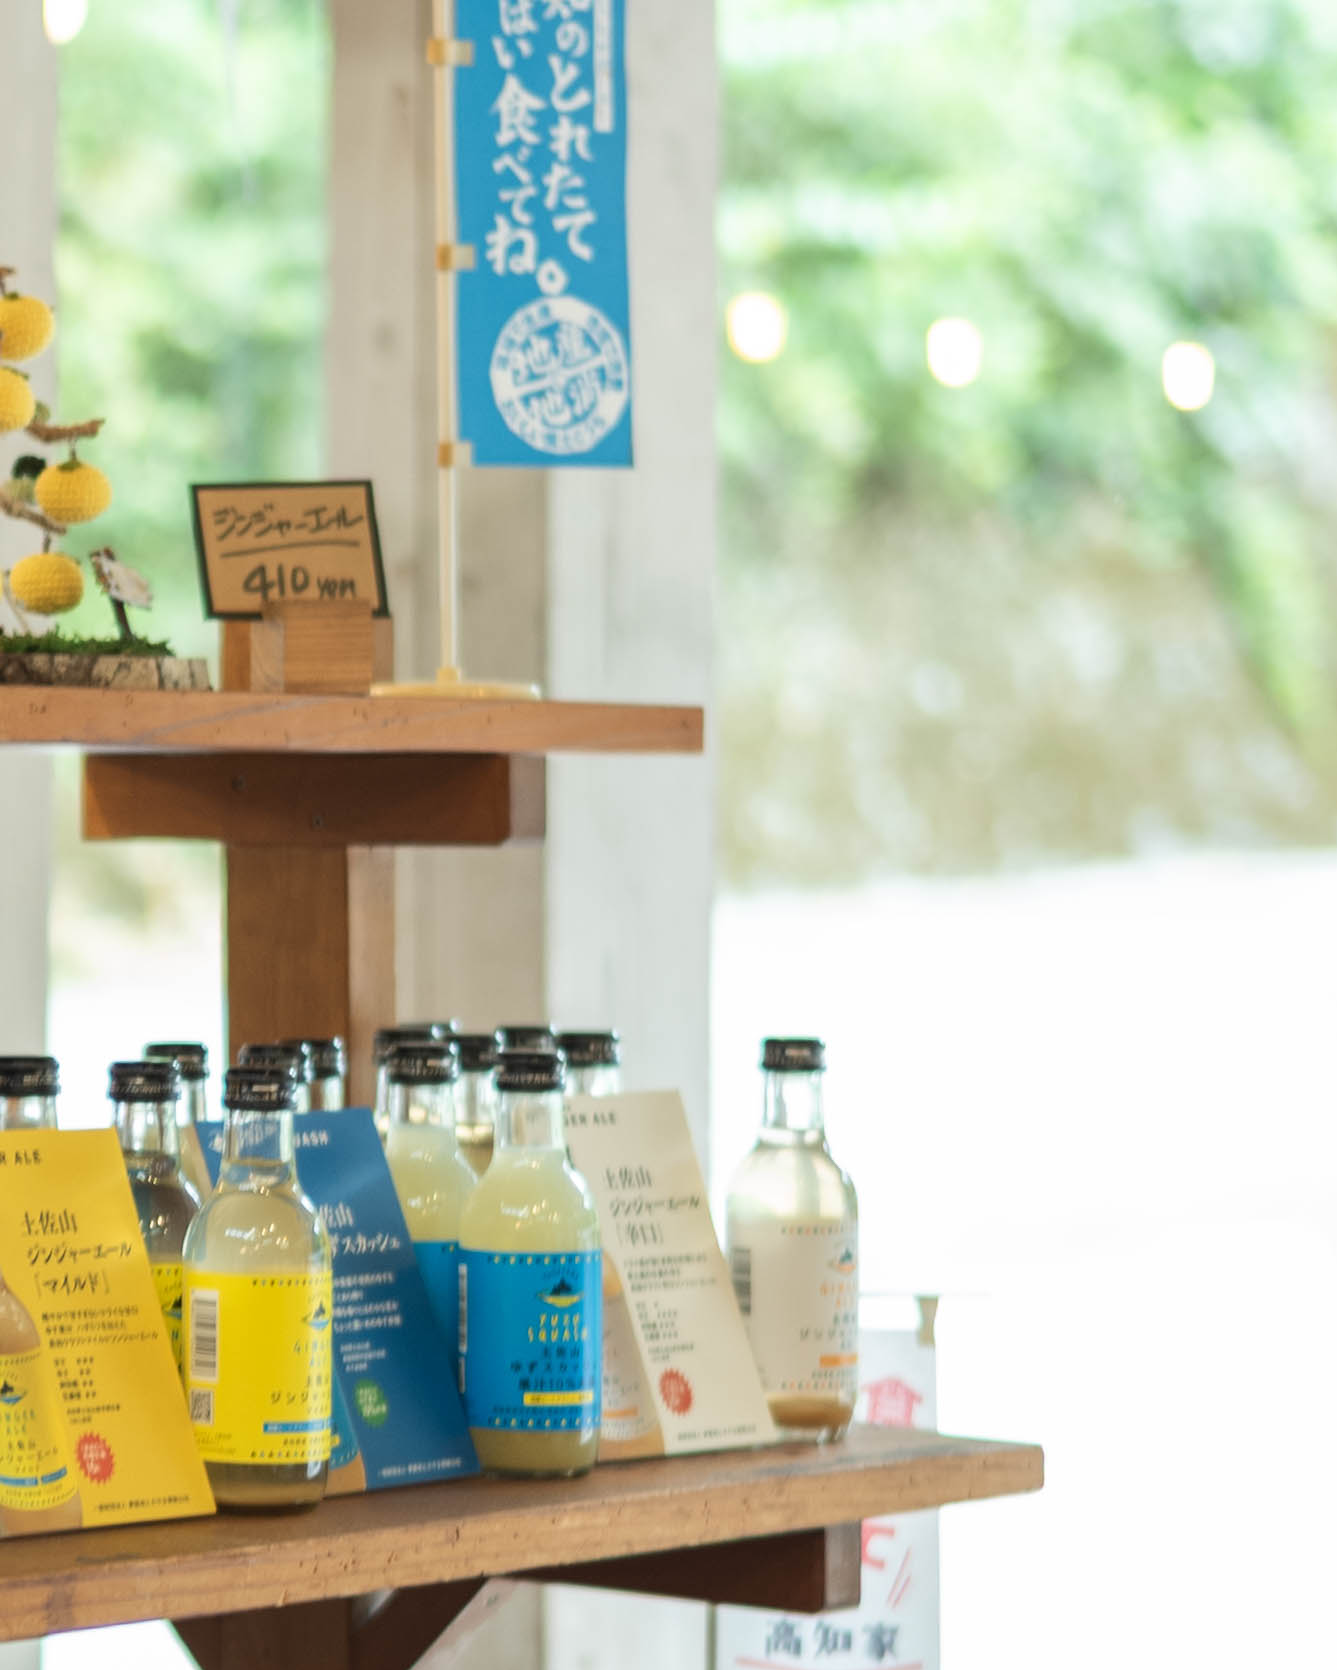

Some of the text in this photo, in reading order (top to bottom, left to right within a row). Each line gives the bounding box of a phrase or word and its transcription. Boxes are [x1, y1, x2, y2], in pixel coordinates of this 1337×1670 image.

[243, 563, 311, 604] 410
[15, 1148, 43, 1166] ALE
[27, 1241, 133, 1267] ジンジャーエール
[765, 1617, 901, 1662] 高知家
